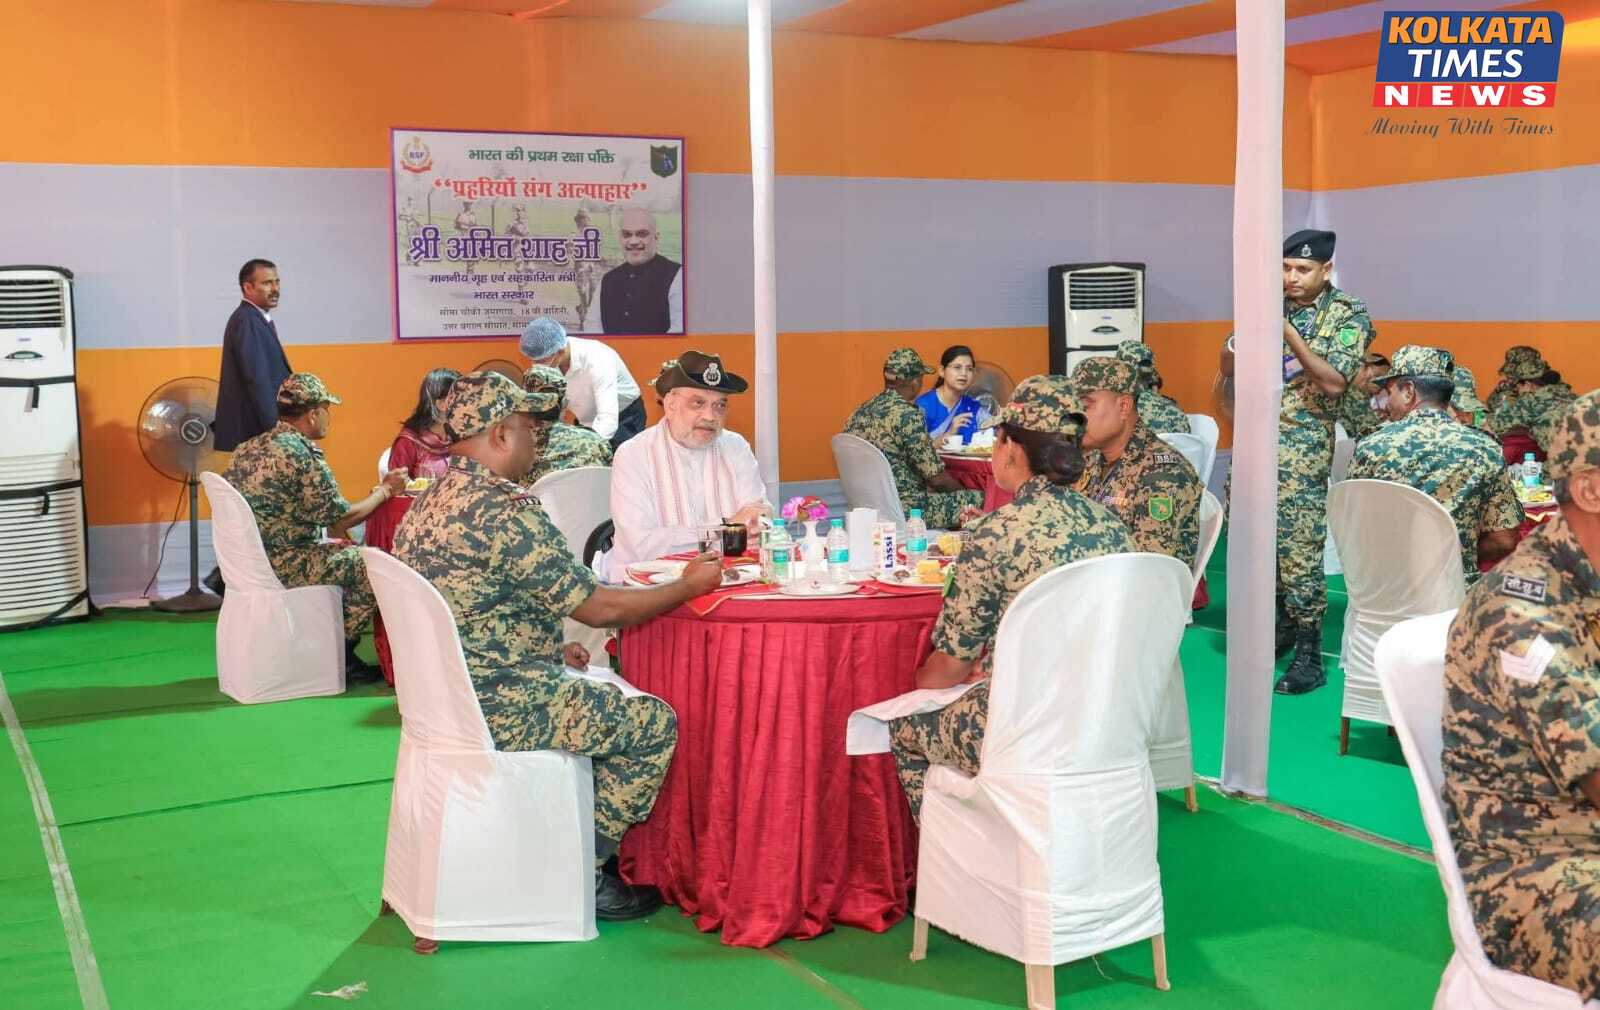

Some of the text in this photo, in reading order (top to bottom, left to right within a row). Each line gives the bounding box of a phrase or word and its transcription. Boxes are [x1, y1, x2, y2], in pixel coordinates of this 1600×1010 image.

[469, 149, 501, 161] भारत
[506, 146, 524, 161] की
[528, 150, 558, 163] प्रथम
[562, 151, 584, 163] रक्षा
[522, 177, 552, 198] संग
[409, 226, 601, 264] श्री अमित शाह जी
[430, 271, 577, 286] माननीय गृह एवं सहकारिता मंत्री
[474, 290, 535, 300] भारत सरकार
[884, 536, 894, 568] Lassi
